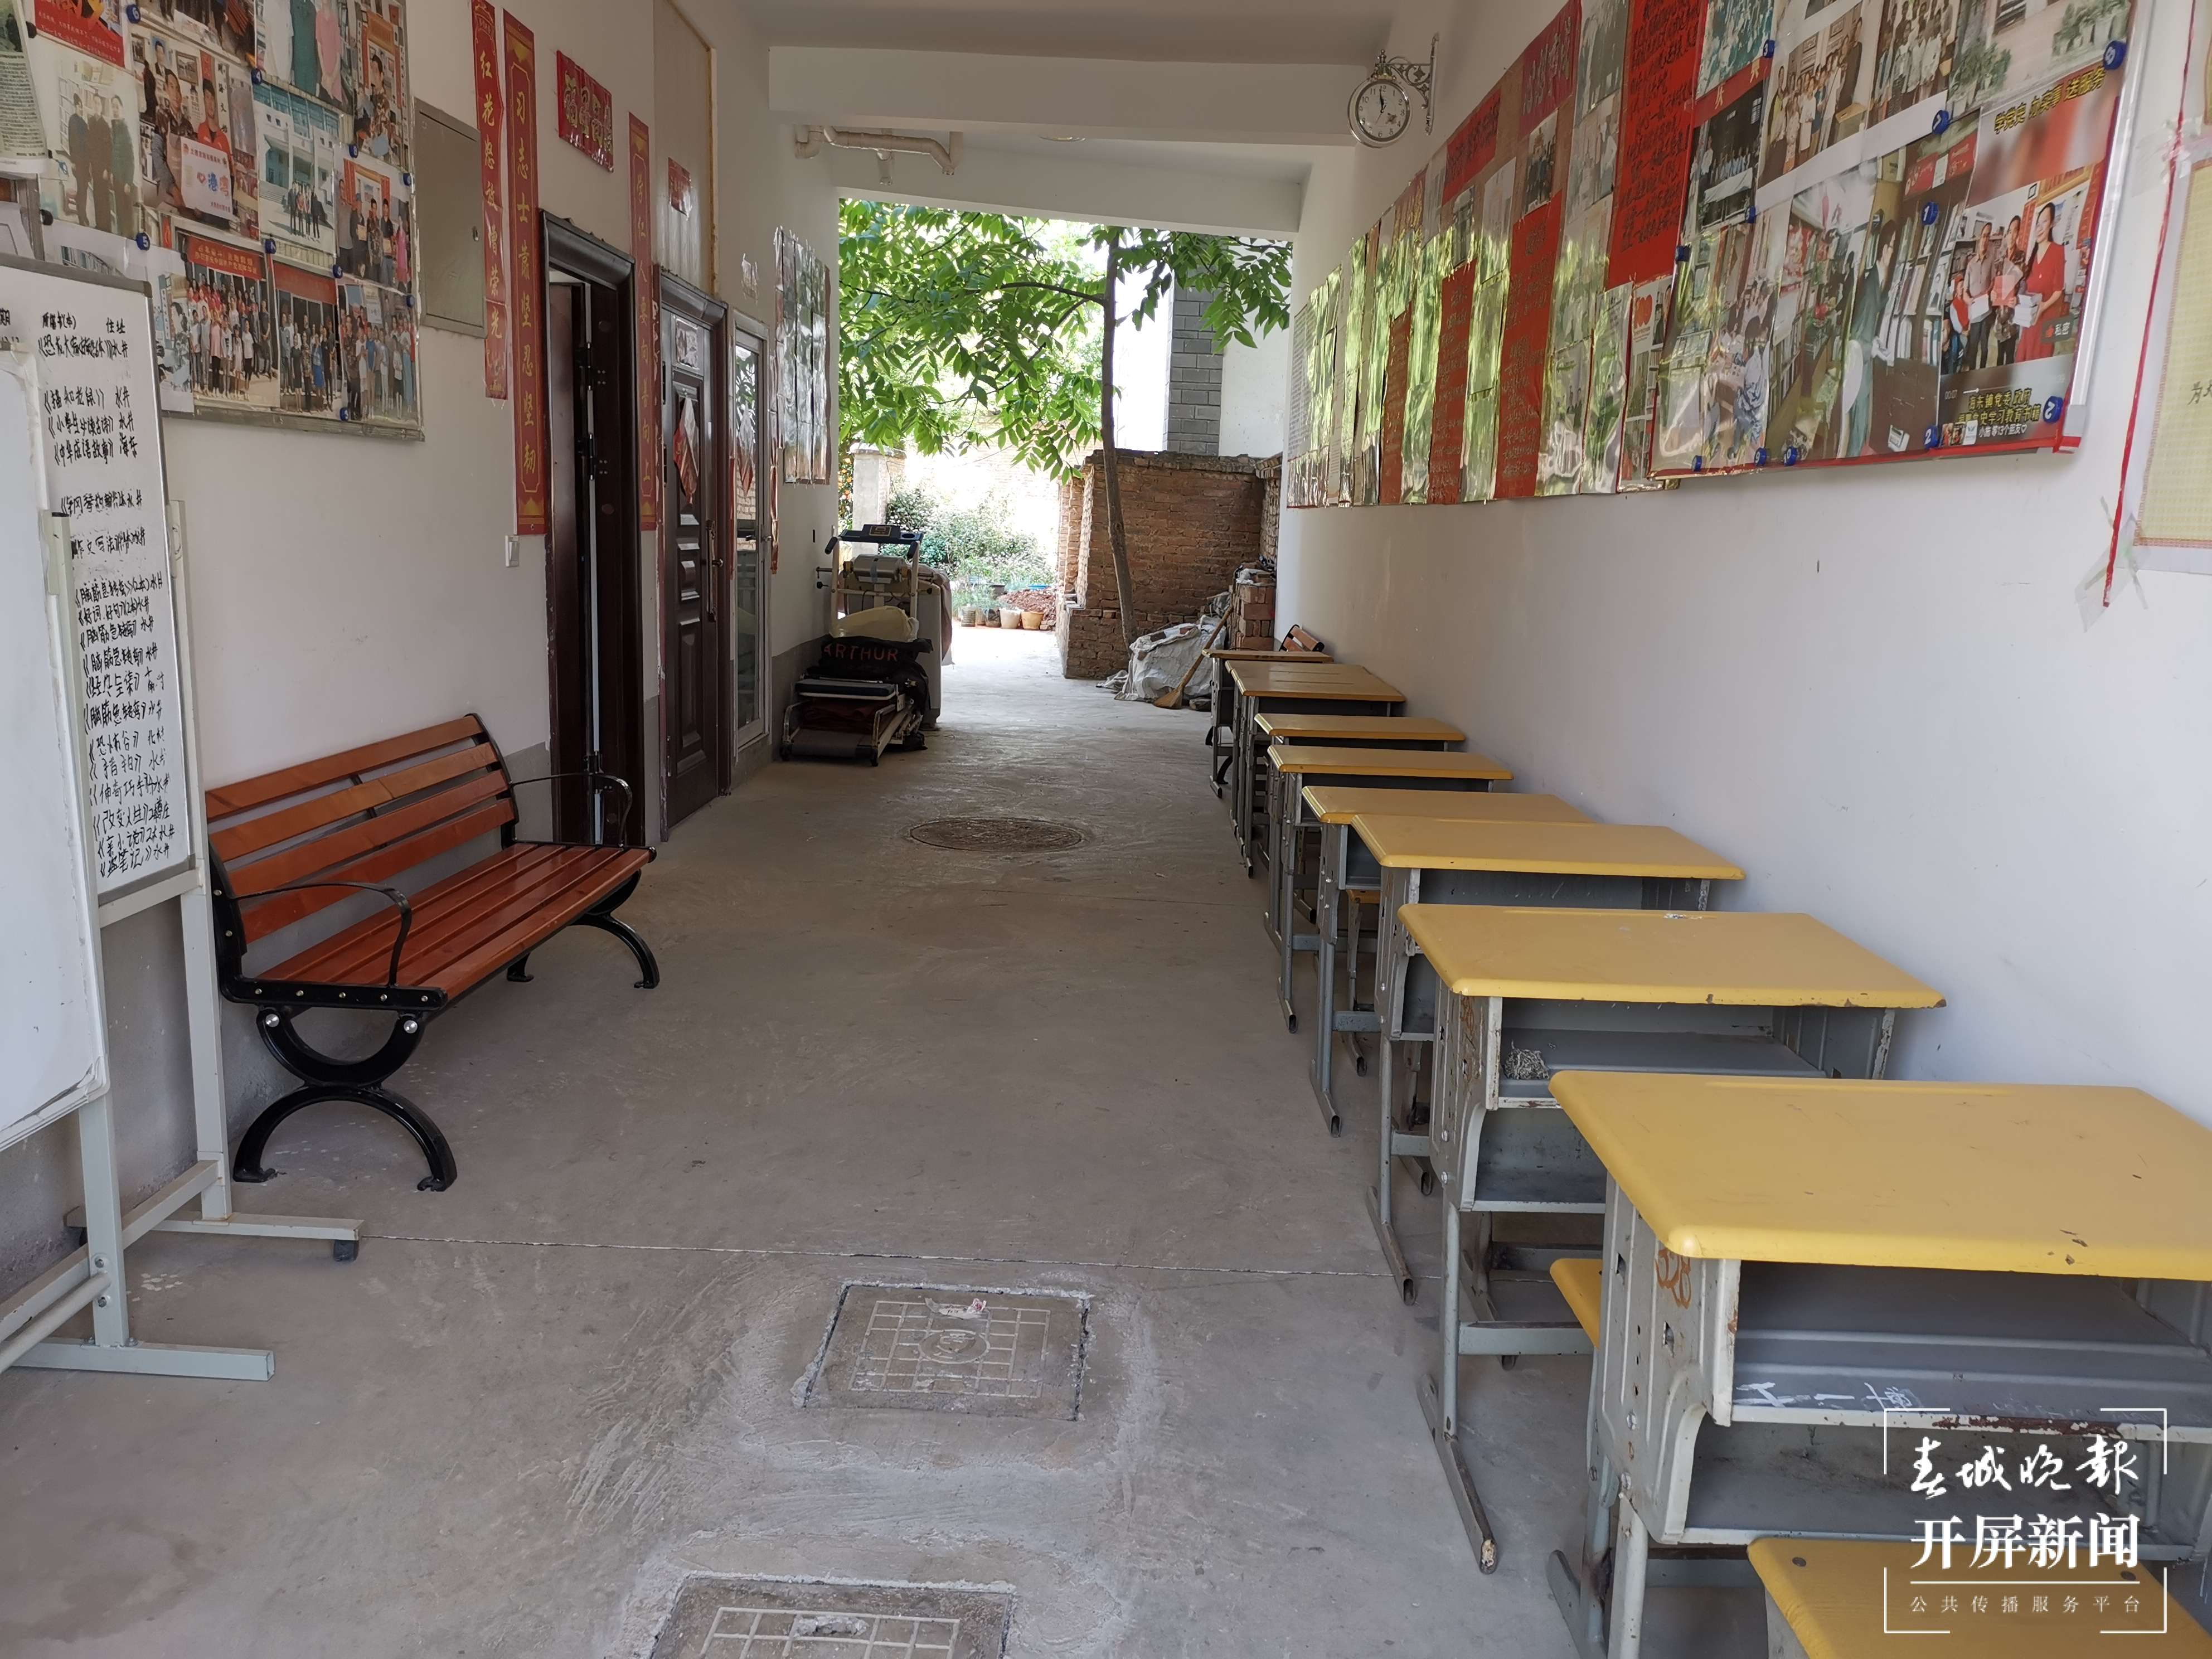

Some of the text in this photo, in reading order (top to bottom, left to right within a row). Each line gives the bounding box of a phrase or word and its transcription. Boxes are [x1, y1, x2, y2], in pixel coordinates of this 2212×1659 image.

[1994, 102, 2026, 134] 学党史
[106, 317, 126, 334] 住址
[115, 385, 130, 409] 水井
[1968, 387, 2032, 411] 海东镇党委 政府
[119, 410, 134, 432] 水井
[823, 642, 899, 662] ARTHUR
